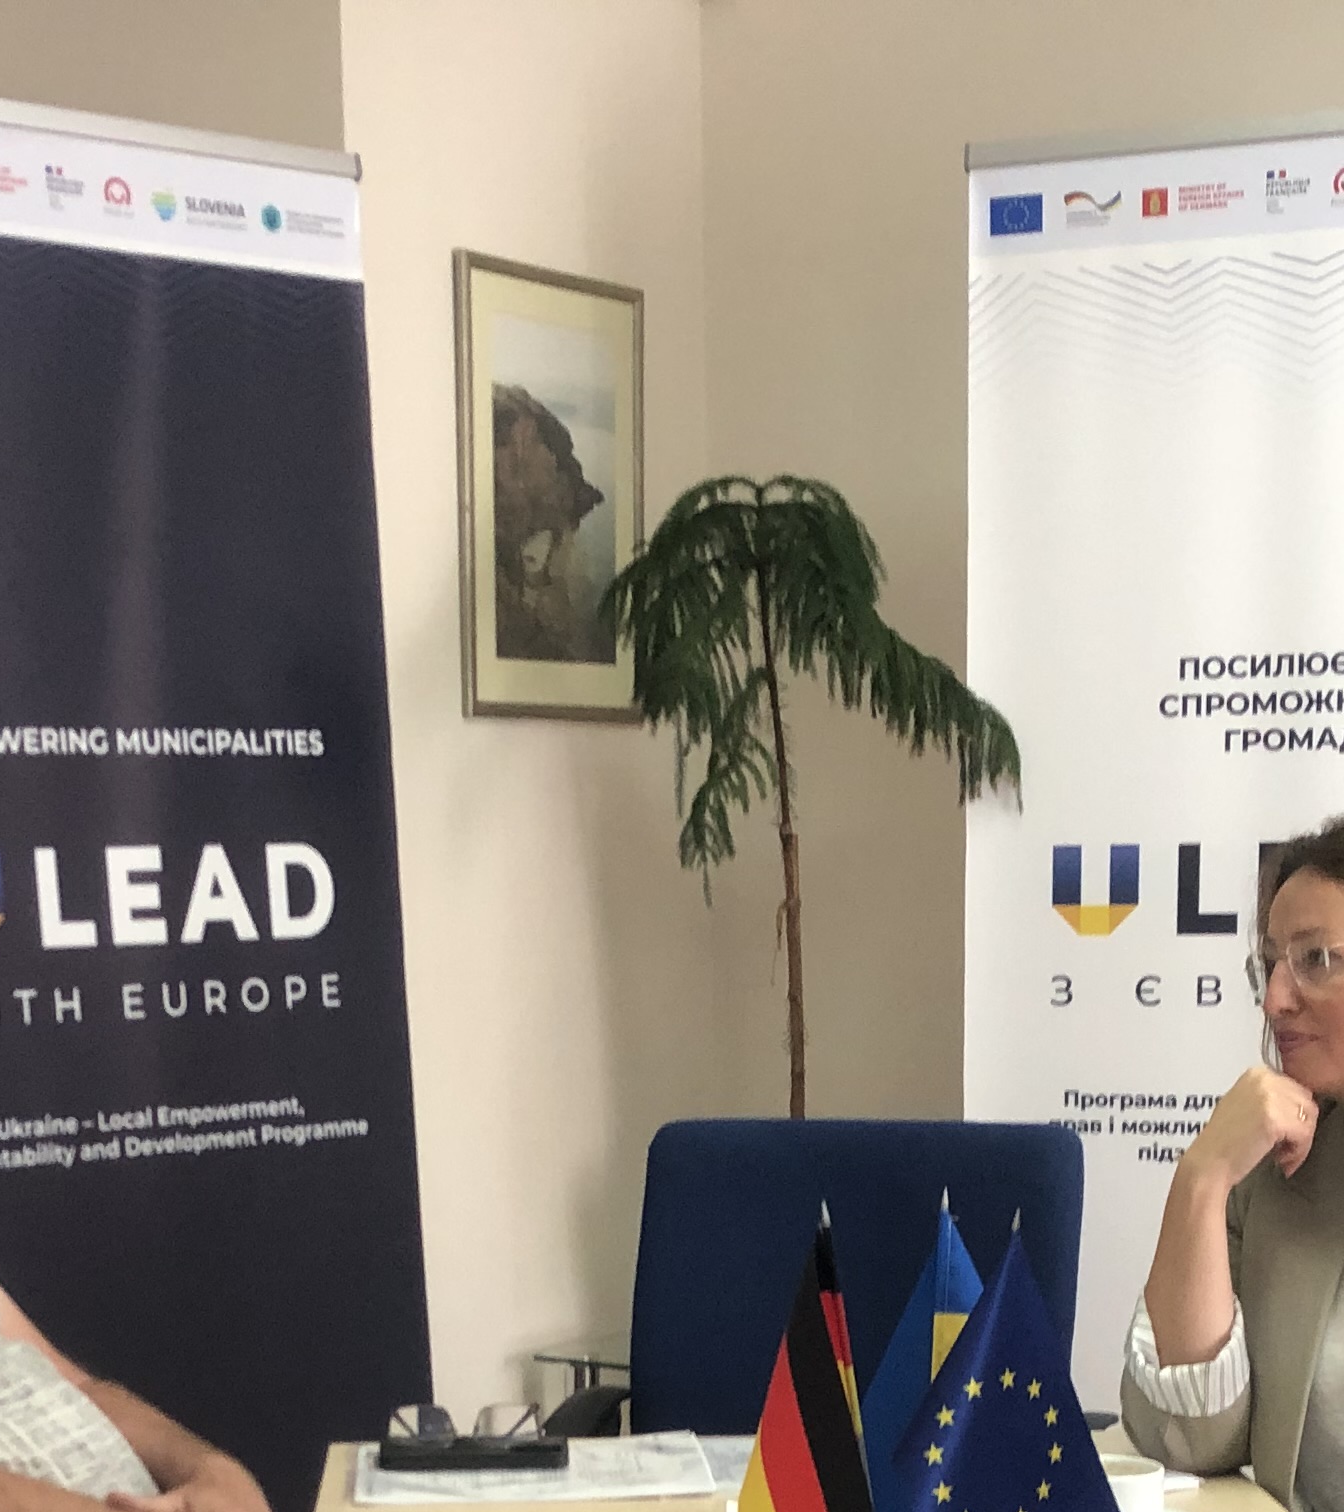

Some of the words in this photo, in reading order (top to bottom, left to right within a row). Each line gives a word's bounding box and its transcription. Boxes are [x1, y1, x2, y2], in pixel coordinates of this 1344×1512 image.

[185, 196, 246, 218] SLOVENIA
[115, 727, 325, 757] MUNICIPALITIES
[33, 841, 336, 951] LEAD
[121, 971, 342, 1021] EUROPE
[97, 1105, 153, 1133] Local
[157, 1096, 305, 1129] Empowerment,
[1064, 1089, 1178, 1112] Програма
[80, 1136, 121, 1162] and
[124, 1125, 257, 1158] Development
[261, 1118, 369, 1147] Programme
[1121, 1120, 1209, 1136] можли
